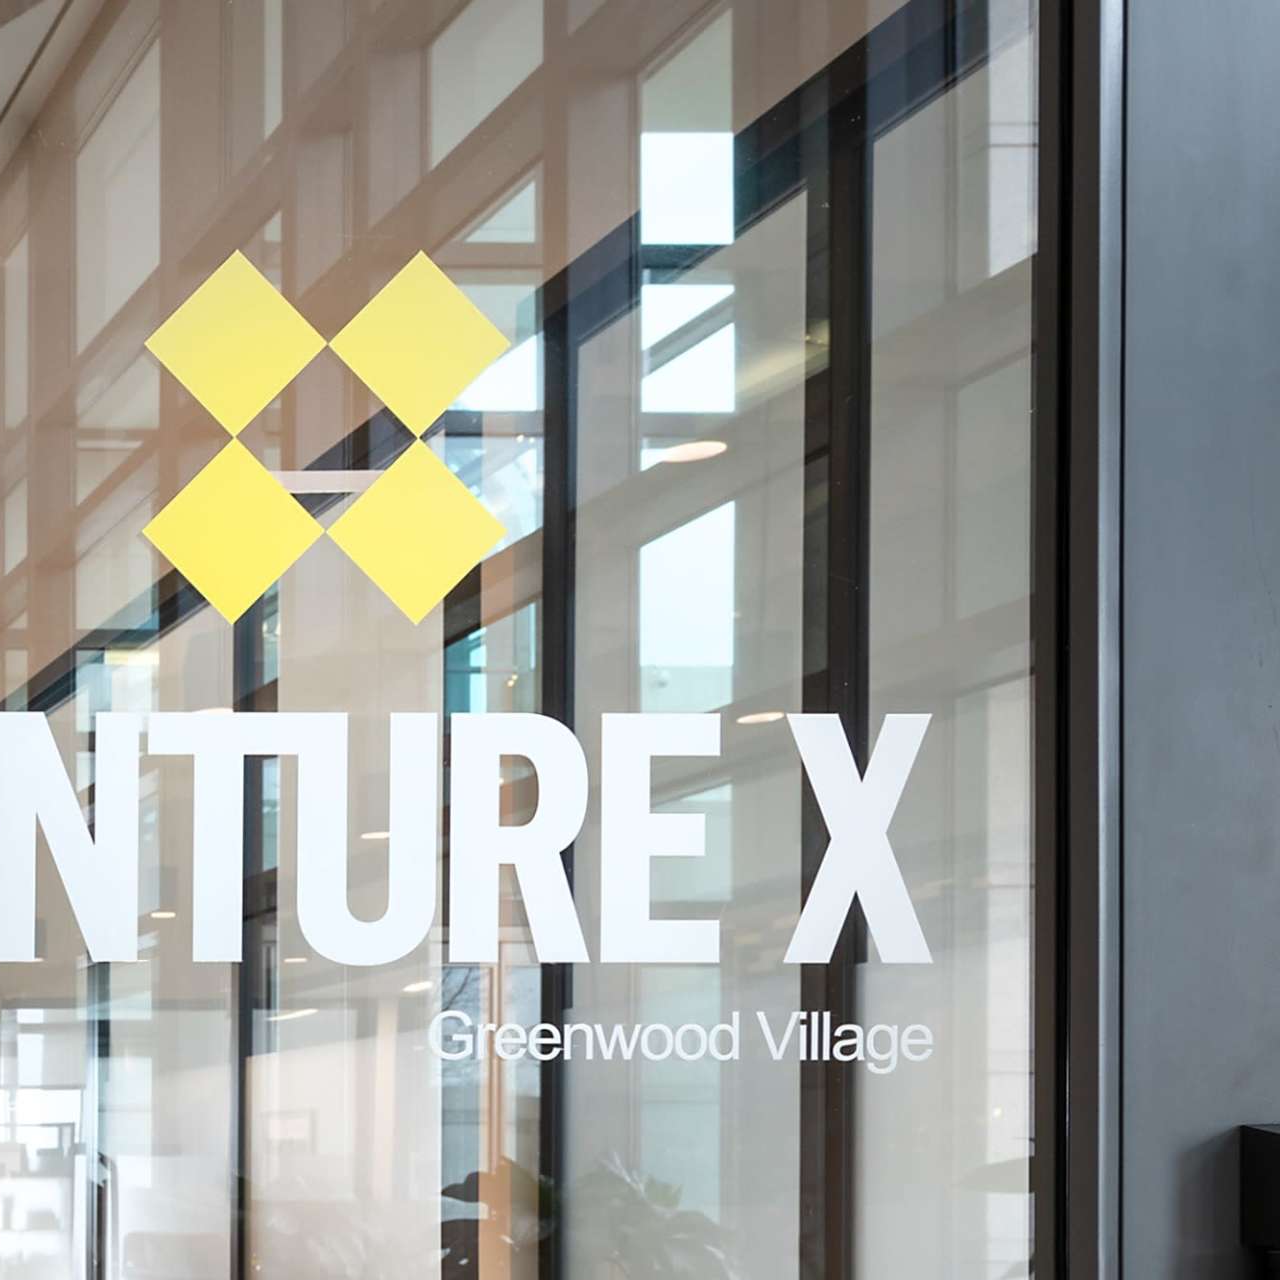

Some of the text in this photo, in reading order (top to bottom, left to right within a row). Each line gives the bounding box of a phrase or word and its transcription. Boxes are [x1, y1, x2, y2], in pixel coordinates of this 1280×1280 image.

[785, 712, 933, 965] X
[427, 1009, 934, 1075] Greenwood Village
